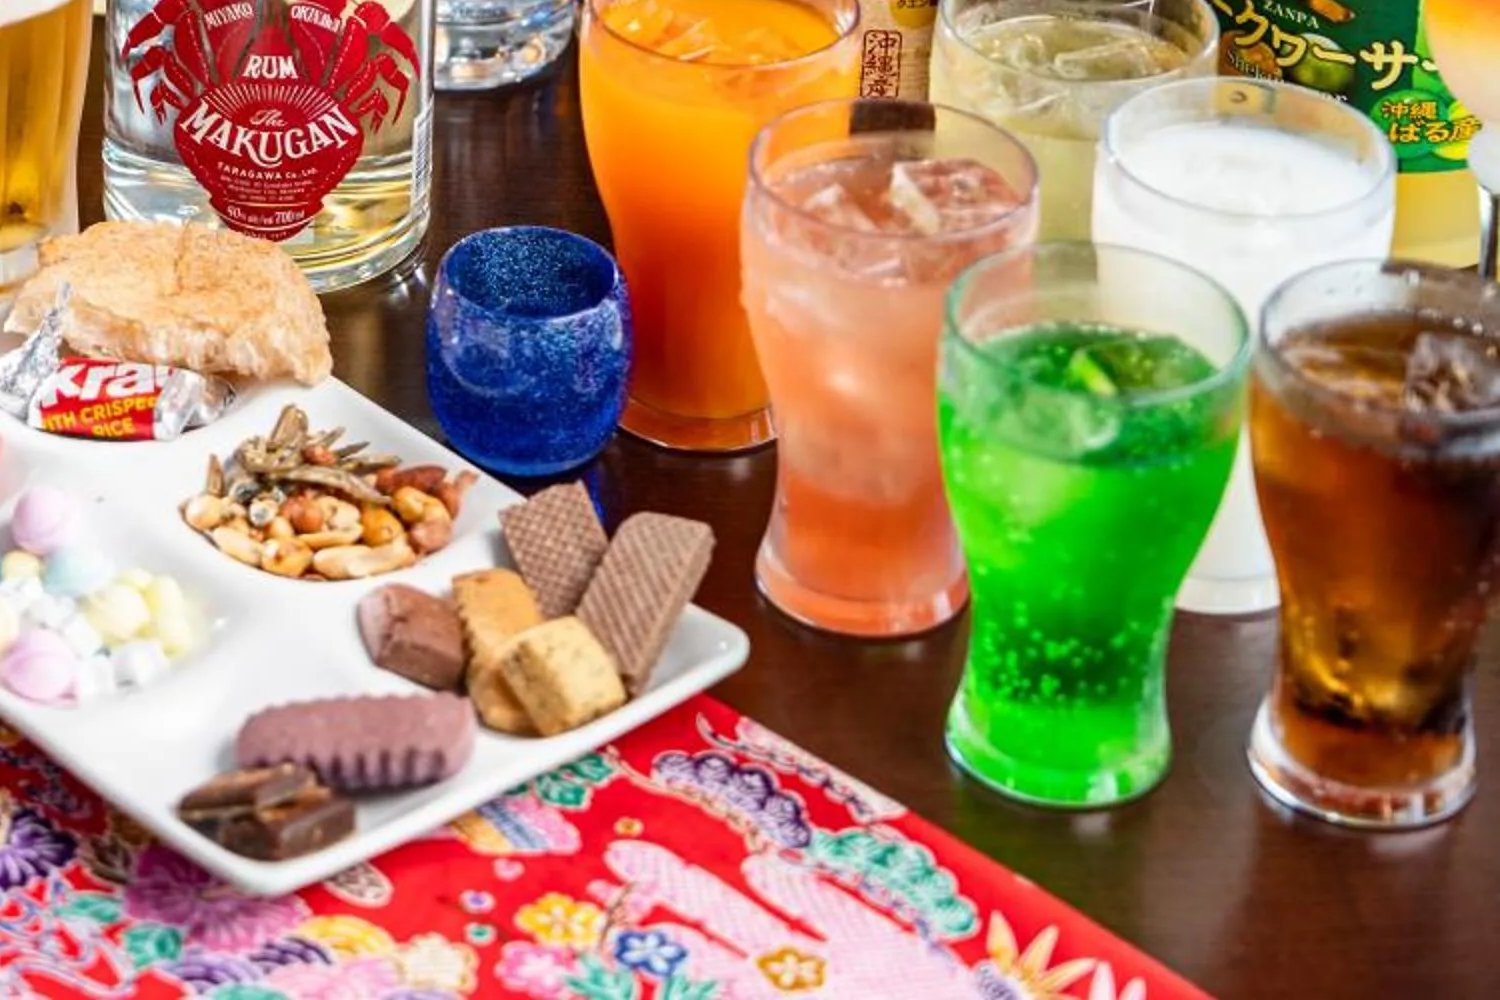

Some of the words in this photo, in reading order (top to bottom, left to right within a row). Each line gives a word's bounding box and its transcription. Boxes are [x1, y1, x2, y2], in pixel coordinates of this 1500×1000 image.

[203, 2, 255, 29] MIYAKO
[290, 3, 344, 33] OKINAWA
[242, 54, 299, 80] RUM
[248, 108, 290, 127] The
[1381, 101, 1438, 120] 沖縄
[179, 102, 360, 169] MAKUGAN
[217, 161, 283, 180] TARAGAWA
[91, 417, 136, 438] RICE
